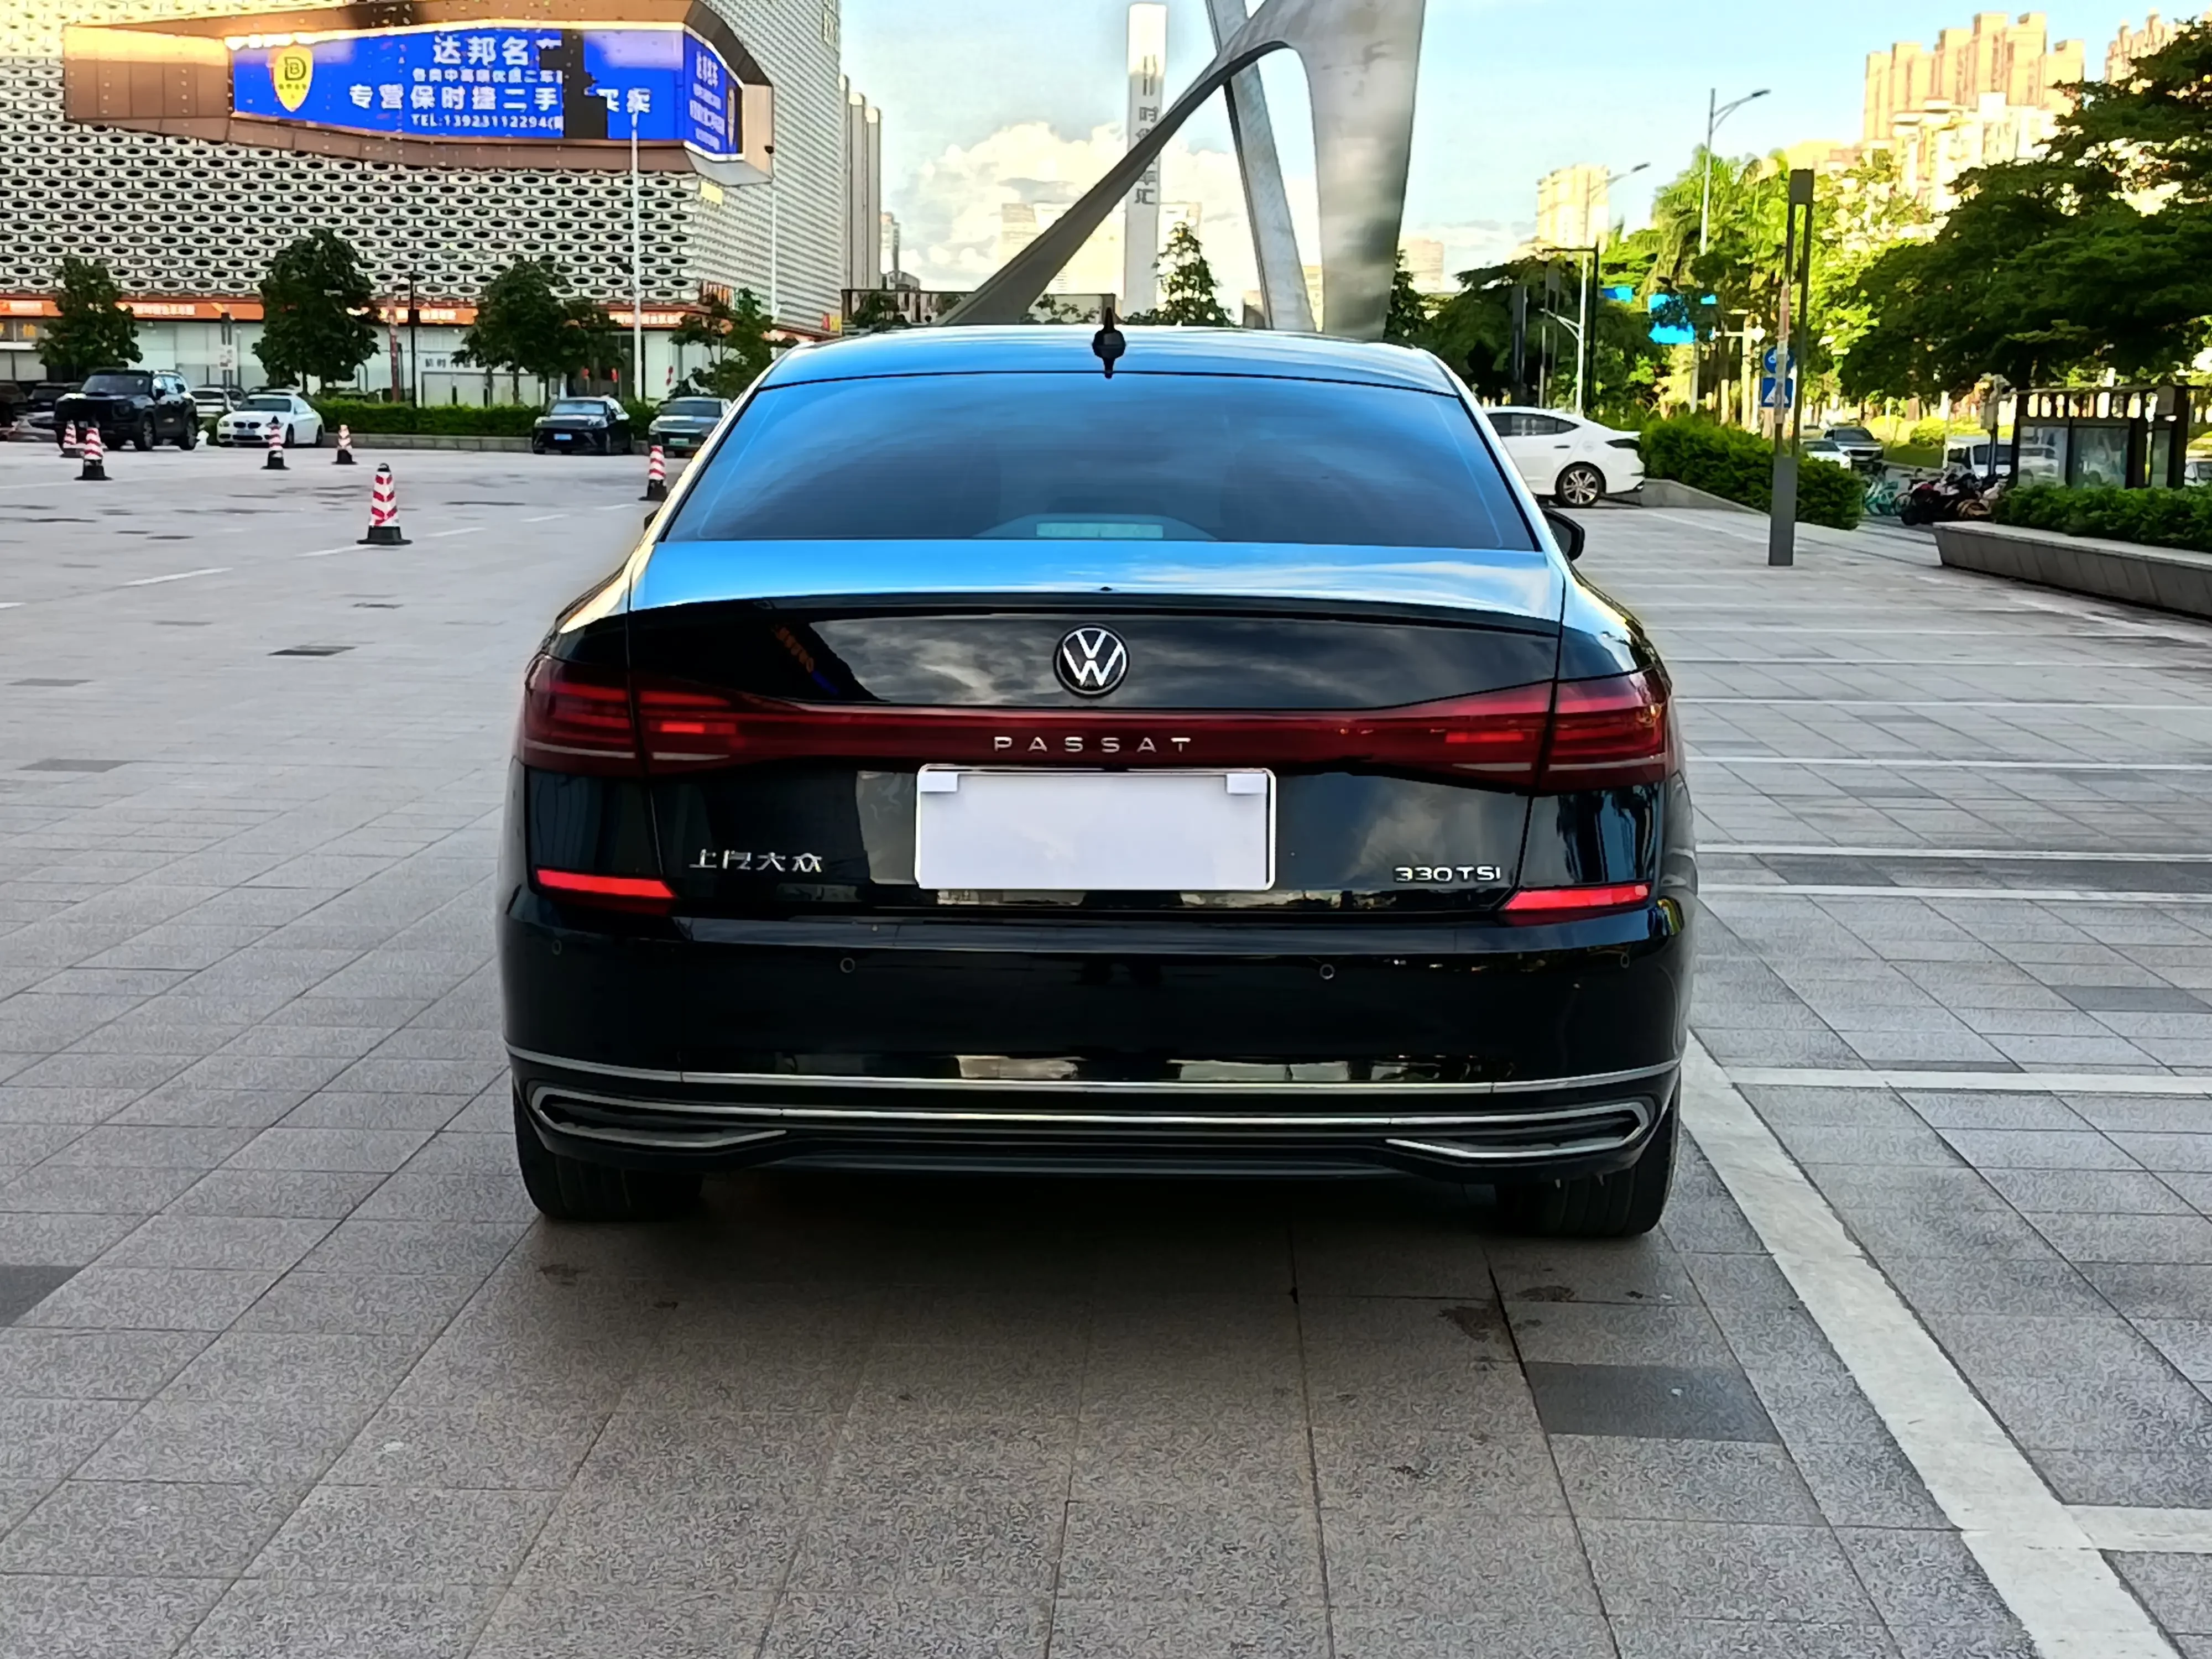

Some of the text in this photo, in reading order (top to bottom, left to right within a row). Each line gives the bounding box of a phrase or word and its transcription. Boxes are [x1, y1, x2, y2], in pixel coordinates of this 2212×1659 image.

[993, 736, 1191, 753] PASSAT
[688, 848, 823, 873] 上汽大众
[1394, 865, 1501, 882] 330TSI
